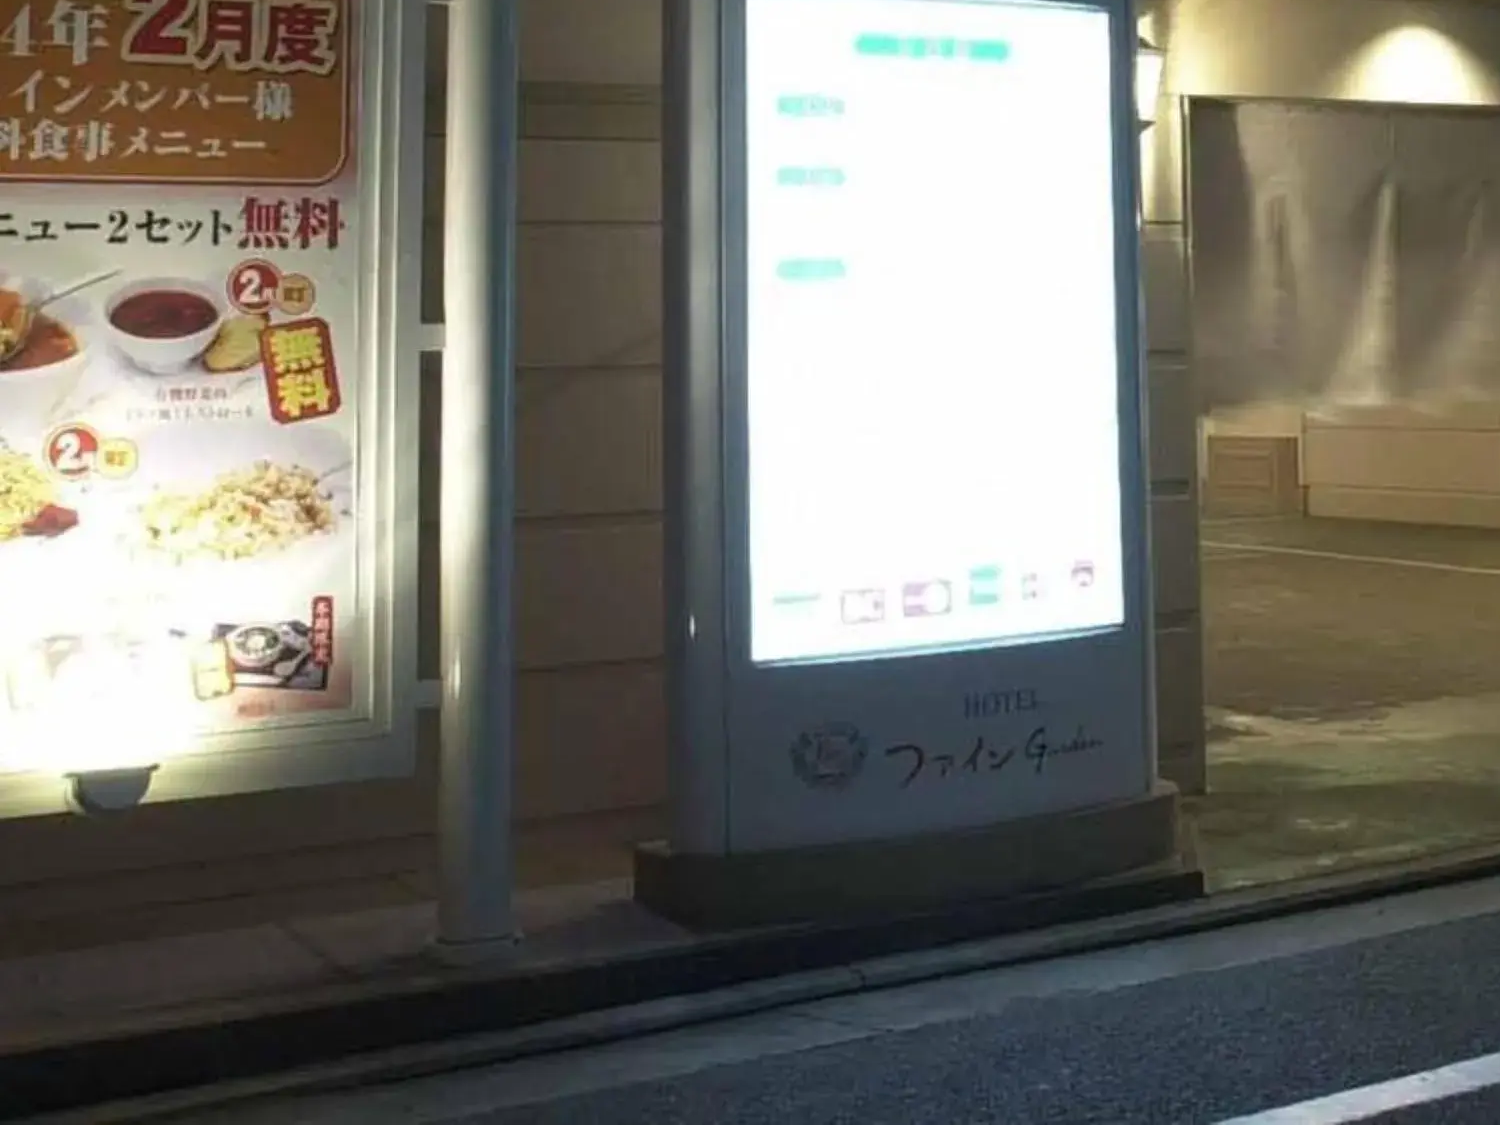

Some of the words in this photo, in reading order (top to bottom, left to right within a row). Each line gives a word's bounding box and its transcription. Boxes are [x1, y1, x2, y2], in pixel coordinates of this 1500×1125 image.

[963, 688, 1045, 720] HOTEL
[884, 735, 1016, 790] ファイン
